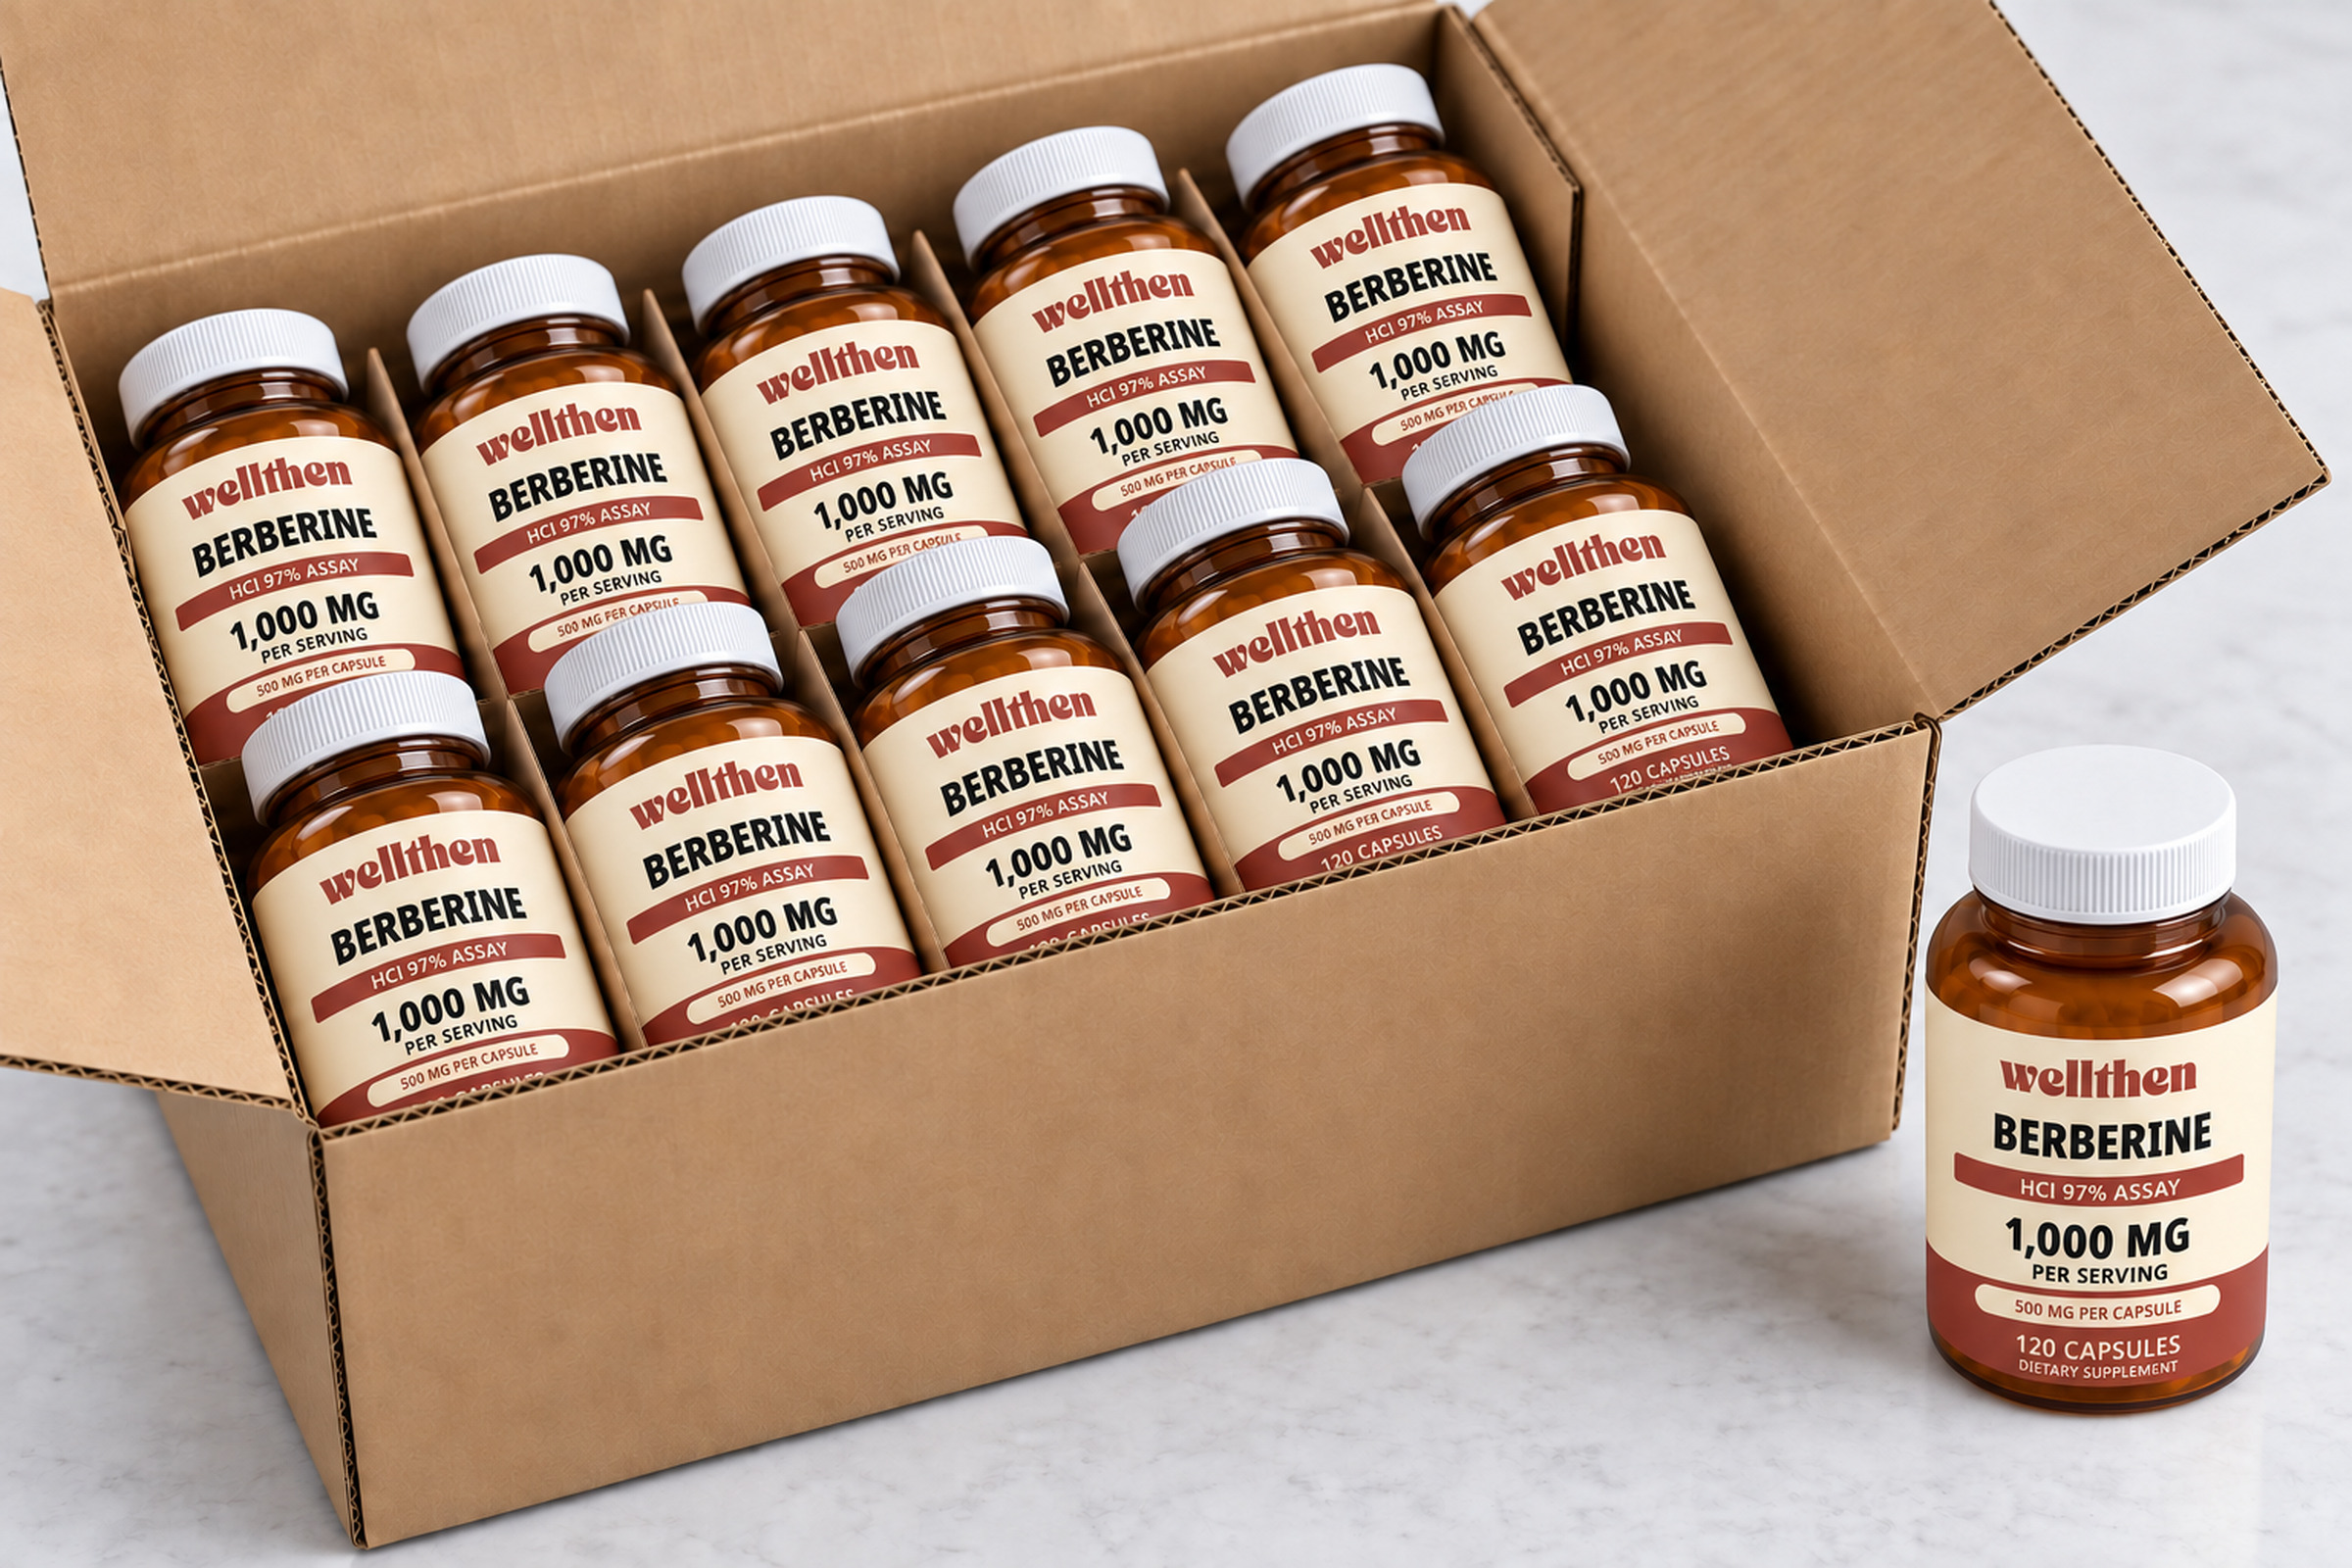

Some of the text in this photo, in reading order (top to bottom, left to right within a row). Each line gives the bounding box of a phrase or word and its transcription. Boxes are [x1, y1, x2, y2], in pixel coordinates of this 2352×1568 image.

[1309, 206, 1471, 269] wellthen
[1031, 270, 1195, 333] wellthen
[1324, 253, 1497, 322] BERBERINE
[1397, 312, 1432, 331] 97%
[1437, 301, 1484, 321] ASSAY
[757, 341, 919, 405] wellthen
[1046, 318, 1221, 387] BERBERINE
[1369, 331, 1505, 390] 1,000 MG
[1119, 377, 1154, 396] 97%
[1158, 367, 1207, 386] ASSAY
[1401, 365, 1497, 401] PER SERVING
[475, 403, 642, 466] wellthen
[770, 391, 947, 461] BERBERINE
[1090, 398, 1228, 455] 1,000 MG
[1400, 416, 1422, 431] 500
[1423, 409, 1445, 423] MG
[843, 450, 878, 470] 97%
[882, 439, 933, 460] ASSAY
[1121, 431, 1219, 466] PER SERVING
[181, 458, 352, 519] wellthen
[489, 453, 667, 521] BERBERINE
[814, 471, 953, 531] 1,000 MG
[1120, 482, 1142, 497] 500
[1144, 474, 1164, 490] MG
[1166, 468, 1188, 481] PER
[560, 512, 596, 532] 97%
[601, 502, 651, 521] ASSAY
[846, 507, 944, 542] PER SERVING
[192, 509, 377, 577] BERBERINE
[529, 535, 672, 593] 1,000 MG
[843, 559, 864, 572] 500
[866, 551, 887, 565] MG
[265, 567, 301, 588] 97%
[306, 559, 359, 578] ASSAY
[560, 570, 662, 606] PER SERVING
[1500, 534, 1666, 601] wellthen
[229, 592, 379, 652] 1,000 MG
[557, 621, 579, 637] 500
[581, 613, 602, 628] MG
[1517, 580, 1695, 656] BERBERINE
[262, 627, 368, 663] PER SERVING
[1212, 610, 1381, 678] wellthen
[1593, 642, 1630, 662] 97%
[1634, 629, 1683, 651] ASSAY
[257, 656, 386, 697] 500 MG PER CAPSULE
[1229, 658, 1410, 734] BERBERINE
[1565, 661, 1707, 722] 1,000 MG
[926, 690, 1097, 759] wellthen
[1305, 721, 1342, 741] 97%
[1347, 708, 1397, 730] ASSAY
[1598, 696, 1699, 734] PER SERVING
[1598, 721, 1719, 764] 500 MG PER CAPSULE
[941, 740, 1124, 817] BERBERINE
[1277, 739, 1421, 803] 1,000 MG
[1310, 774, 1413, 813] PER SERVING
[1610, 773, 1642, 795] 120
[1646, 747, 1730, 779] CAPSULES
[629, 760, 804, 830] wellthen
[1016, 804, 1054, 824] 97%
[1057, 792, 1109, 813] ASSAY
[1309, 800, 1433, 845] 500 MG PER CAPSULE
[319, 835, 501, 905] wellthen
[643, 811, 831, 890] BERBERINE
[986, 824, 1132, 887] 1,000 MG
[1321, 825, 1443, 871] 120 CAPSULES
[719, 877, 758, 898] 97%
[762, 863, 814, 887] ASSAY
[1019, 860, 1122, 900] PER SERVING
[330, 888, 527, 965] BERBERINE
[687, 897, 838, 963] 1,000 MG
[1017, 886, 1143, 931] 500 MG PER CAPSULE
[408, 956, 447, 975] 97%
[452, 942, 509, 964] ASSAY
[720, 934, 827, 975] PER SERVING
[718, 961, 848, 1007] 500 MG PER CAPSULE
[371, 976, 530, 1044] 1,000 MG
[405, 1014, 517, 1055] PER SERVING
[401, 1044, 538, 1090] 500 MG PER CAPSULE
[1999, 1058, 2197, 1098] wellthen
[1993, 1111, 2211, 1159] BERBERINE
[2063, 1184, 2107, 1200] 97%
[2114, 1179, 2180, 1200] ASSAY
[2006, 1217, 2189, 1259] 1,000 MG
[2033, 1264, 2168, 1284] PER SERVING
[2015, 1300, 2181, 1320] 500 MG PER CAPSULE
[2016, 1335, 2180, 1360] 120 CAPSULES
[2019, 1359, 2179, 1379] DIETARY SUPPLEMENT
